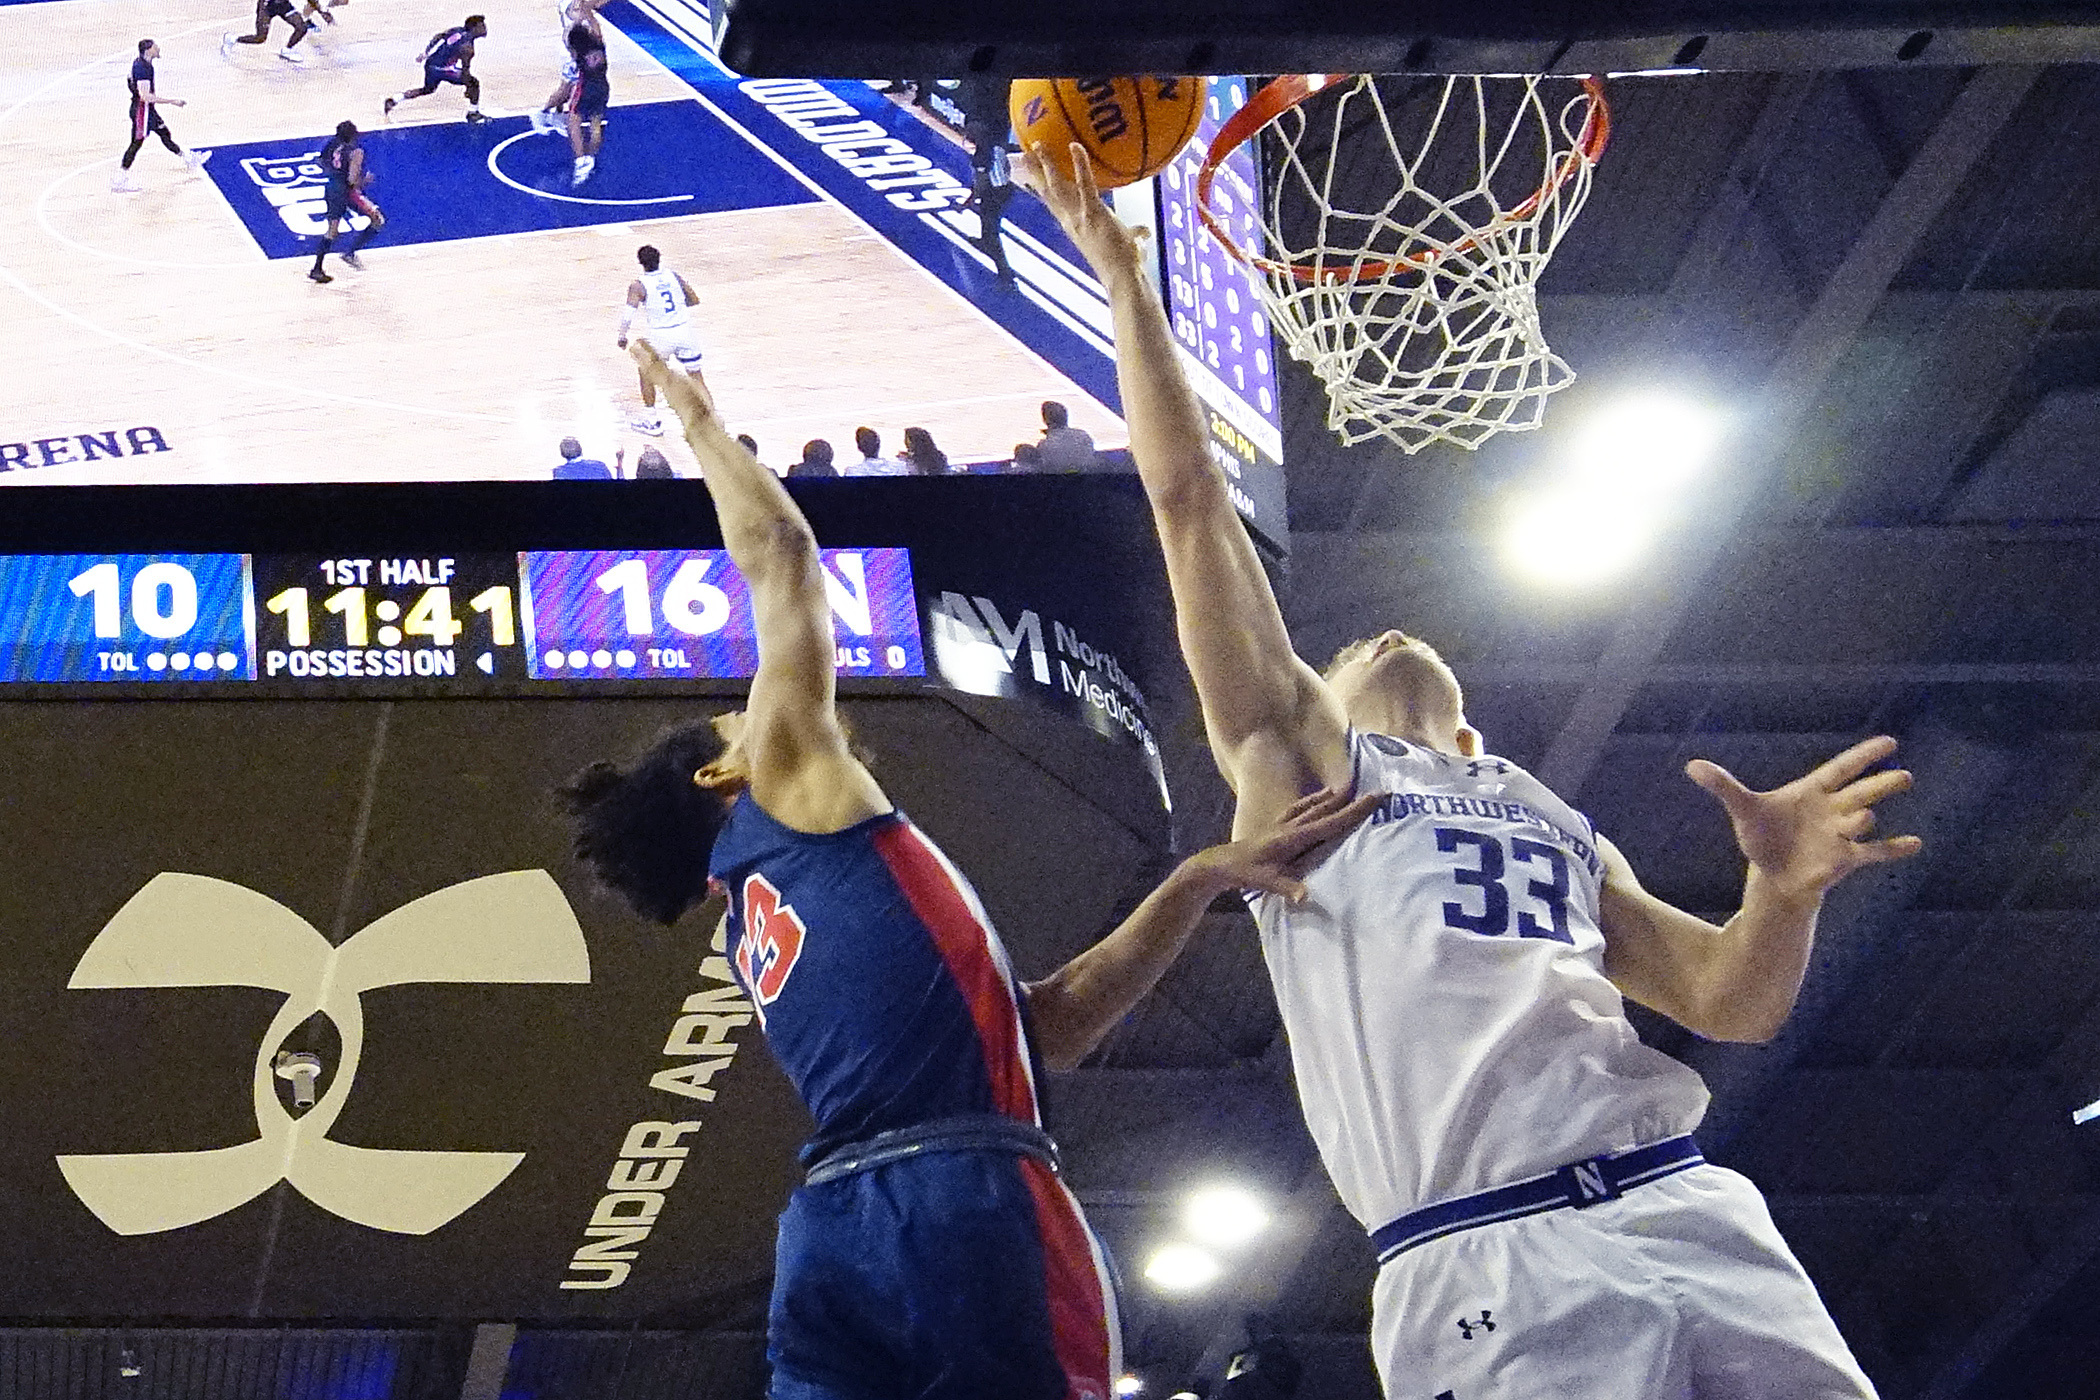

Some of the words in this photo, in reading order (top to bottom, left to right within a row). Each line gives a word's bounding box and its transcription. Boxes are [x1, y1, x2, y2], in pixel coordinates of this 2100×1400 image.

[738, 79, 973, 210] WILDCATS
[1203, 301, 1217, 330] 0
[1256, 347, 1270, 375] 0
[1207, 339, 1221, 369] 2
[1259, 385, 1273, 414] 0
[68, 562, 198, 639] 10
[319, 558, 372, 585] 1ST
[380, 558, 456, 585] HALF
[596, 559, 731, 635] 16
[266, 586, 515, 647] 11:41
[98, 651, 140, 671] TOL
[266, 650, 456, 677] POSSESSION
[646, 648, 692, 668] TOL
[886, 645, 907, 669] 0
[1434, 827, 1576, 946] 33
[559, 1120, 702, 1290] UNDER
[1574, 1161, 1607, 1199] N
